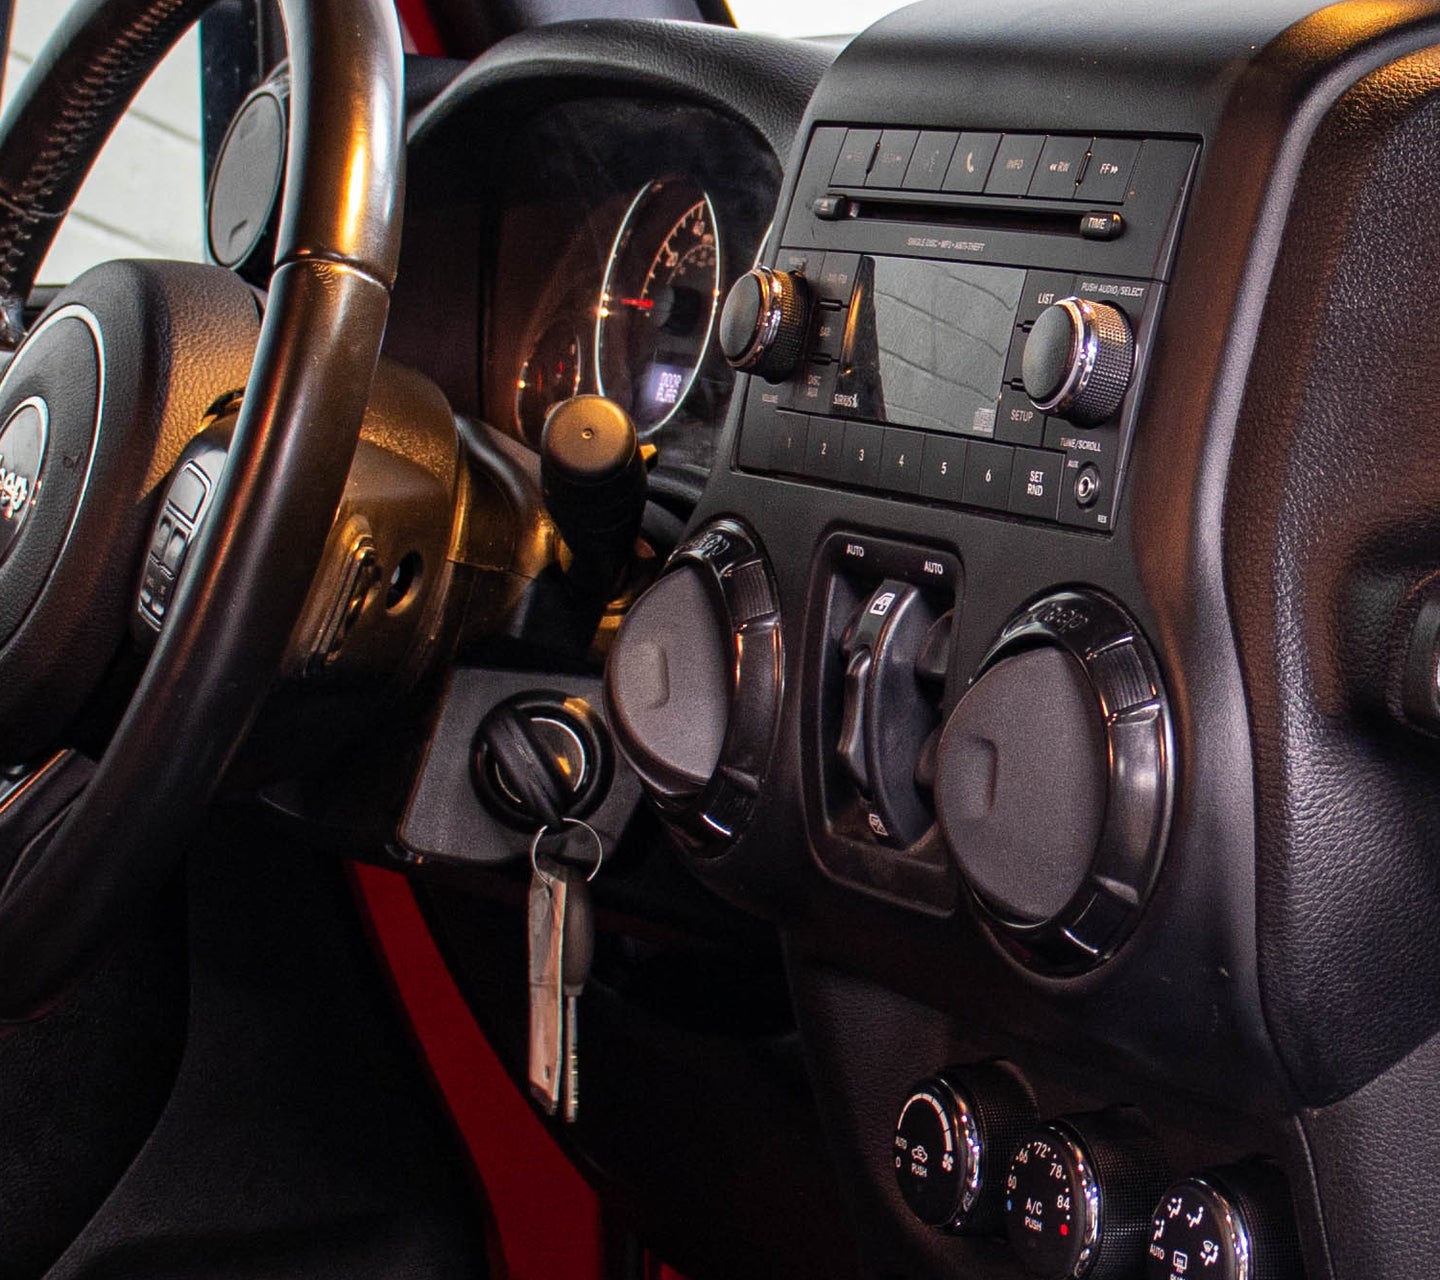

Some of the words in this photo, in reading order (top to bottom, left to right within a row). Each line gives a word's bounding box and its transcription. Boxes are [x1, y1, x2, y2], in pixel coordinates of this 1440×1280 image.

[1100, 163, 1111, 175] FF
[1088, 217, 1107, 230] TIME
[1081, 282, 1098, 293] PUSH
[1098, 285, 1145, 297] AUDIO/SELECT
[1038, 293, 1055, 304] LIST
[1011, 409, 1034, 422] SETUP
[821, 443, 827, 455] 2
[1060, 437, 1102, 452] TUNE/SCROLL
[858, 449, 865, 462] 3
[898, 454, 905, 467] 4
[941, 462, 947, 475] 5
[985, 469, 992, 482] 6
[1029, 470, 1044, 483] SET
[1027, 483, 1044, 497] RND
[846, 543, 865, 558] AUTO
[923, 560, 944, 575] AUTO
[895, 1135, 908, 1151] AUTO
[1035, 1142, 1047, 1159] 72
[1019, 1148, 1029, 1164] 66
[911, 1162, 928, 1178] PUSH
[1049, 1163, 1063, 1179] 78
[1007, 1174, 1017, 1190] 60
[1025, 1197, 1043, 1216] A/C
[1057, 1195, 1071, 1211] 84
[1024, 1216, 1043, 1232] PUSH
[1149, 1243, 1166, 1261] AUTO
